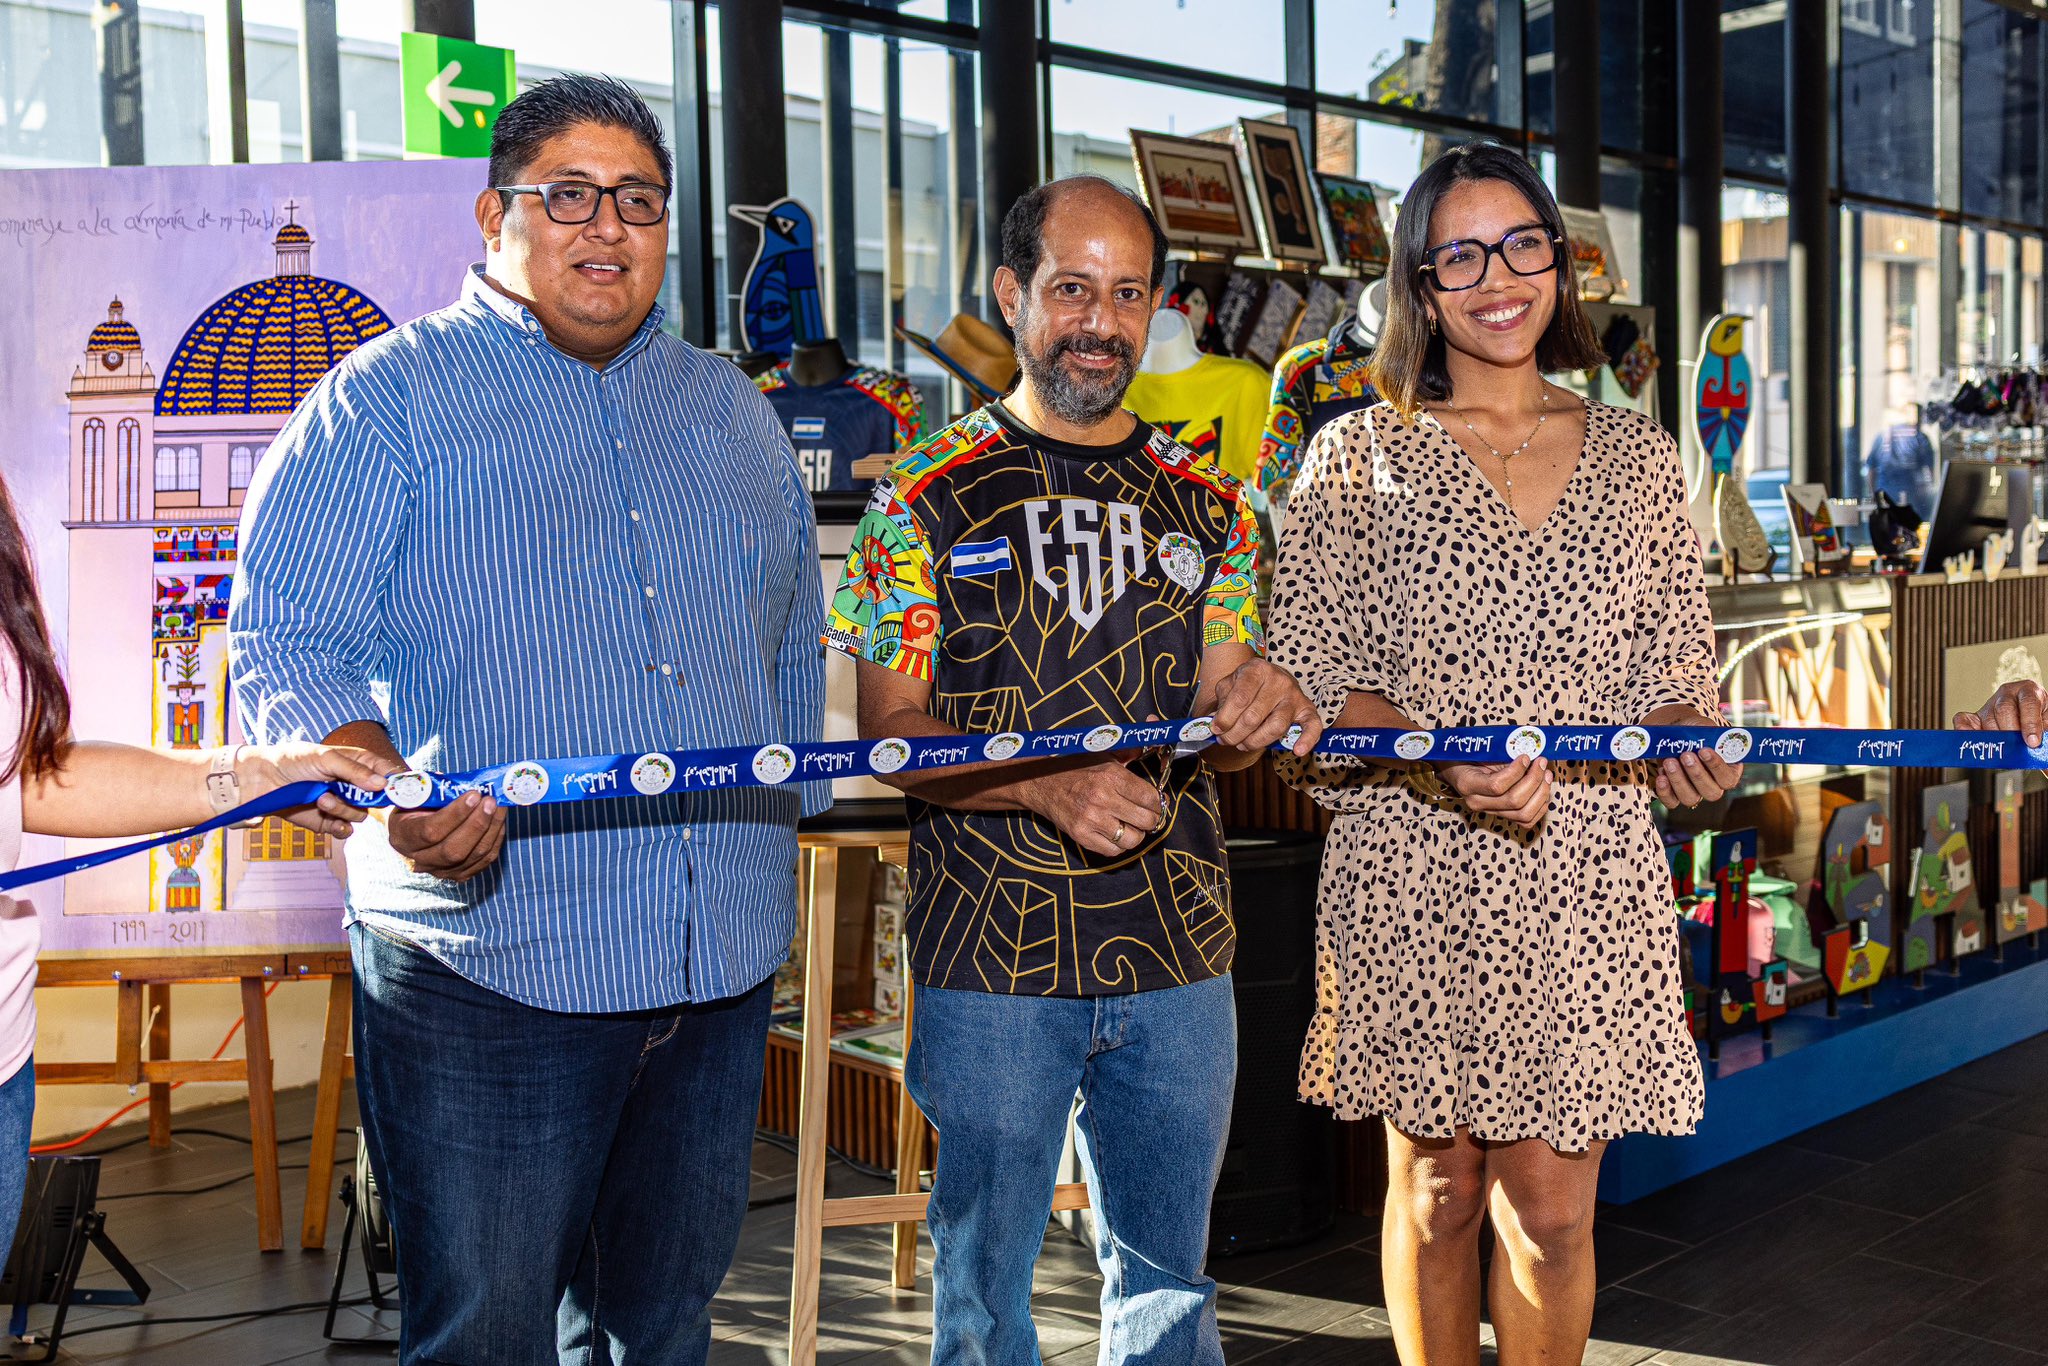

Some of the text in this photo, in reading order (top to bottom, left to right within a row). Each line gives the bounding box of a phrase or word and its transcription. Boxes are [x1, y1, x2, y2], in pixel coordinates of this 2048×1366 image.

[0, 217, 75, 248] omenaje
[799, 449, 833, 492] SA
[1024, 499, 1147, 632] ESA
[112, 920, 147, 944] 1999
[168, 920, 206, 943] 2011
